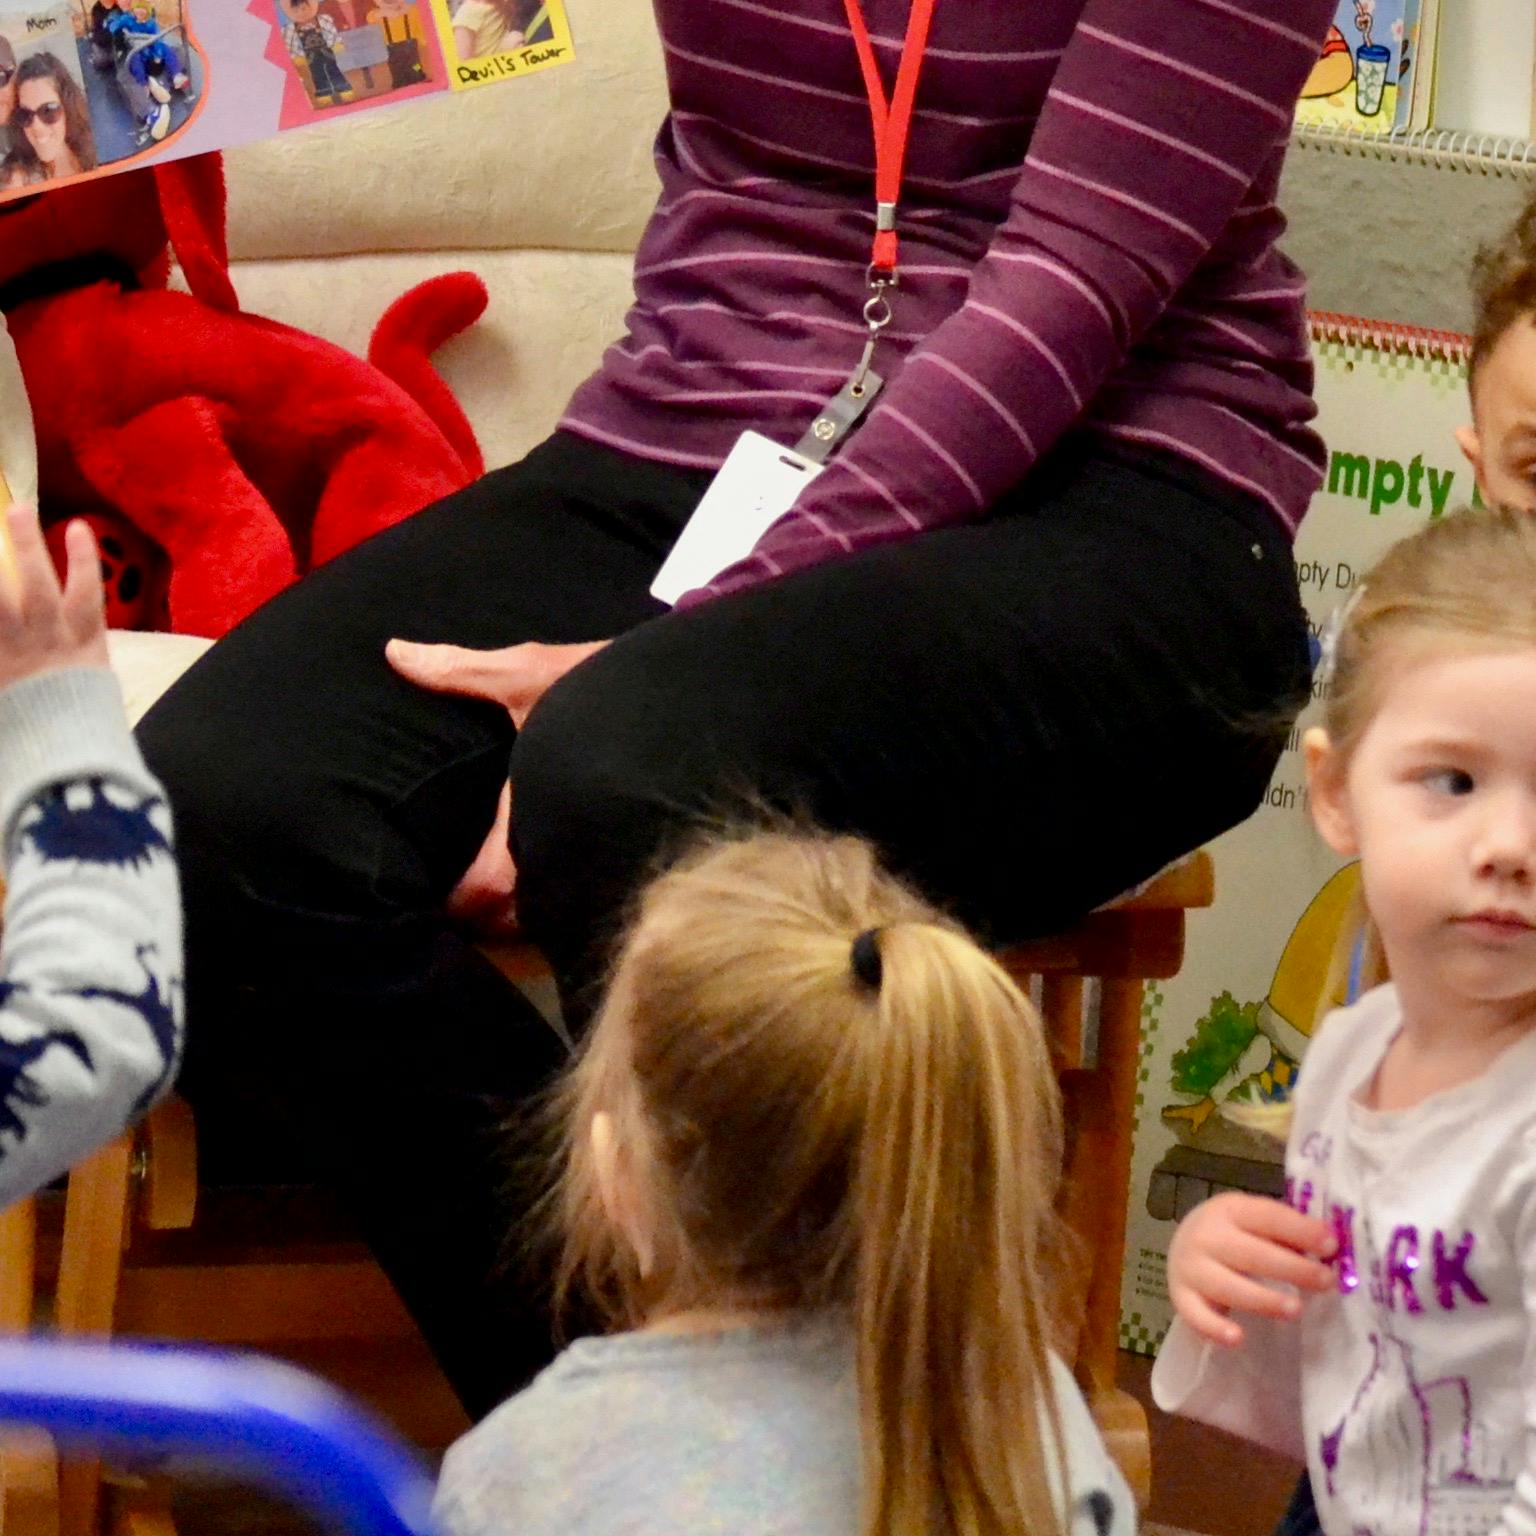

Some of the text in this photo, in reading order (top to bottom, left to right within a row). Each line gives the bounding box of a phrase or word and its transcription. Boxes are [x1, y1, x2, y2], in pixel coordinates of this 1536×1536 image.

[26, 17, 57, 32] Mom
[457, 46, 567, 84] Devil's Tower
